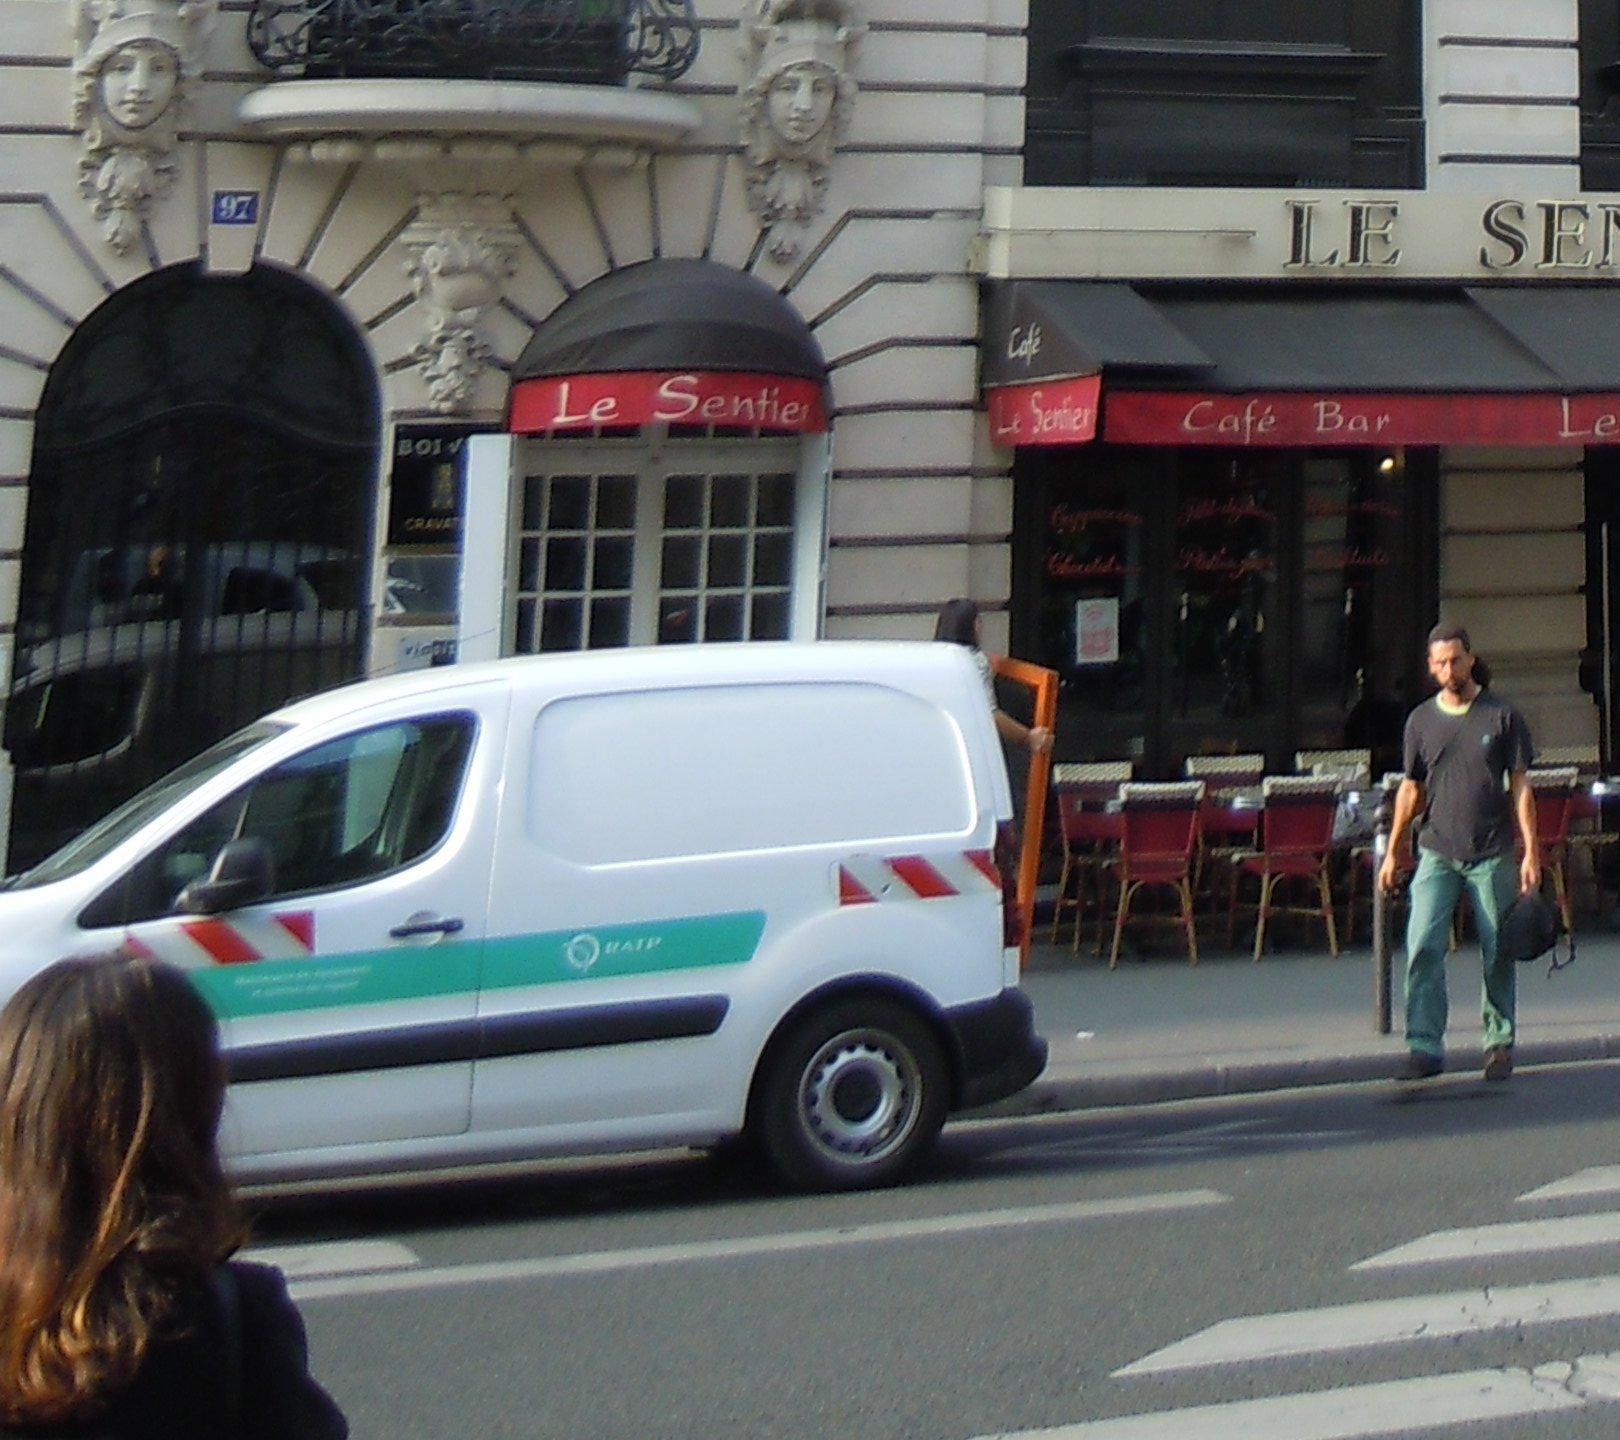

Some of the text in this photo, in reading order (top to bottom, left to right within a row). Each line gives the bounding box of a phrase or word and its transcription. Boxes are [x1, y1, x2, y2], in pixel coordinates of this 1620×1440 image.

[220, 194, 253, 220] 97
[1283, 198, 1403, 269] LE
[1007, 322, 1041, 366] Café
[553, 374, 809, 424] Le Sentier
[997, 390, 1091, 434] Le Sentier
[1183, 399, 1277, 444] Café
[1313, 400, 1390, 432] Bar
[1558, 397, 1620, 438] Le
